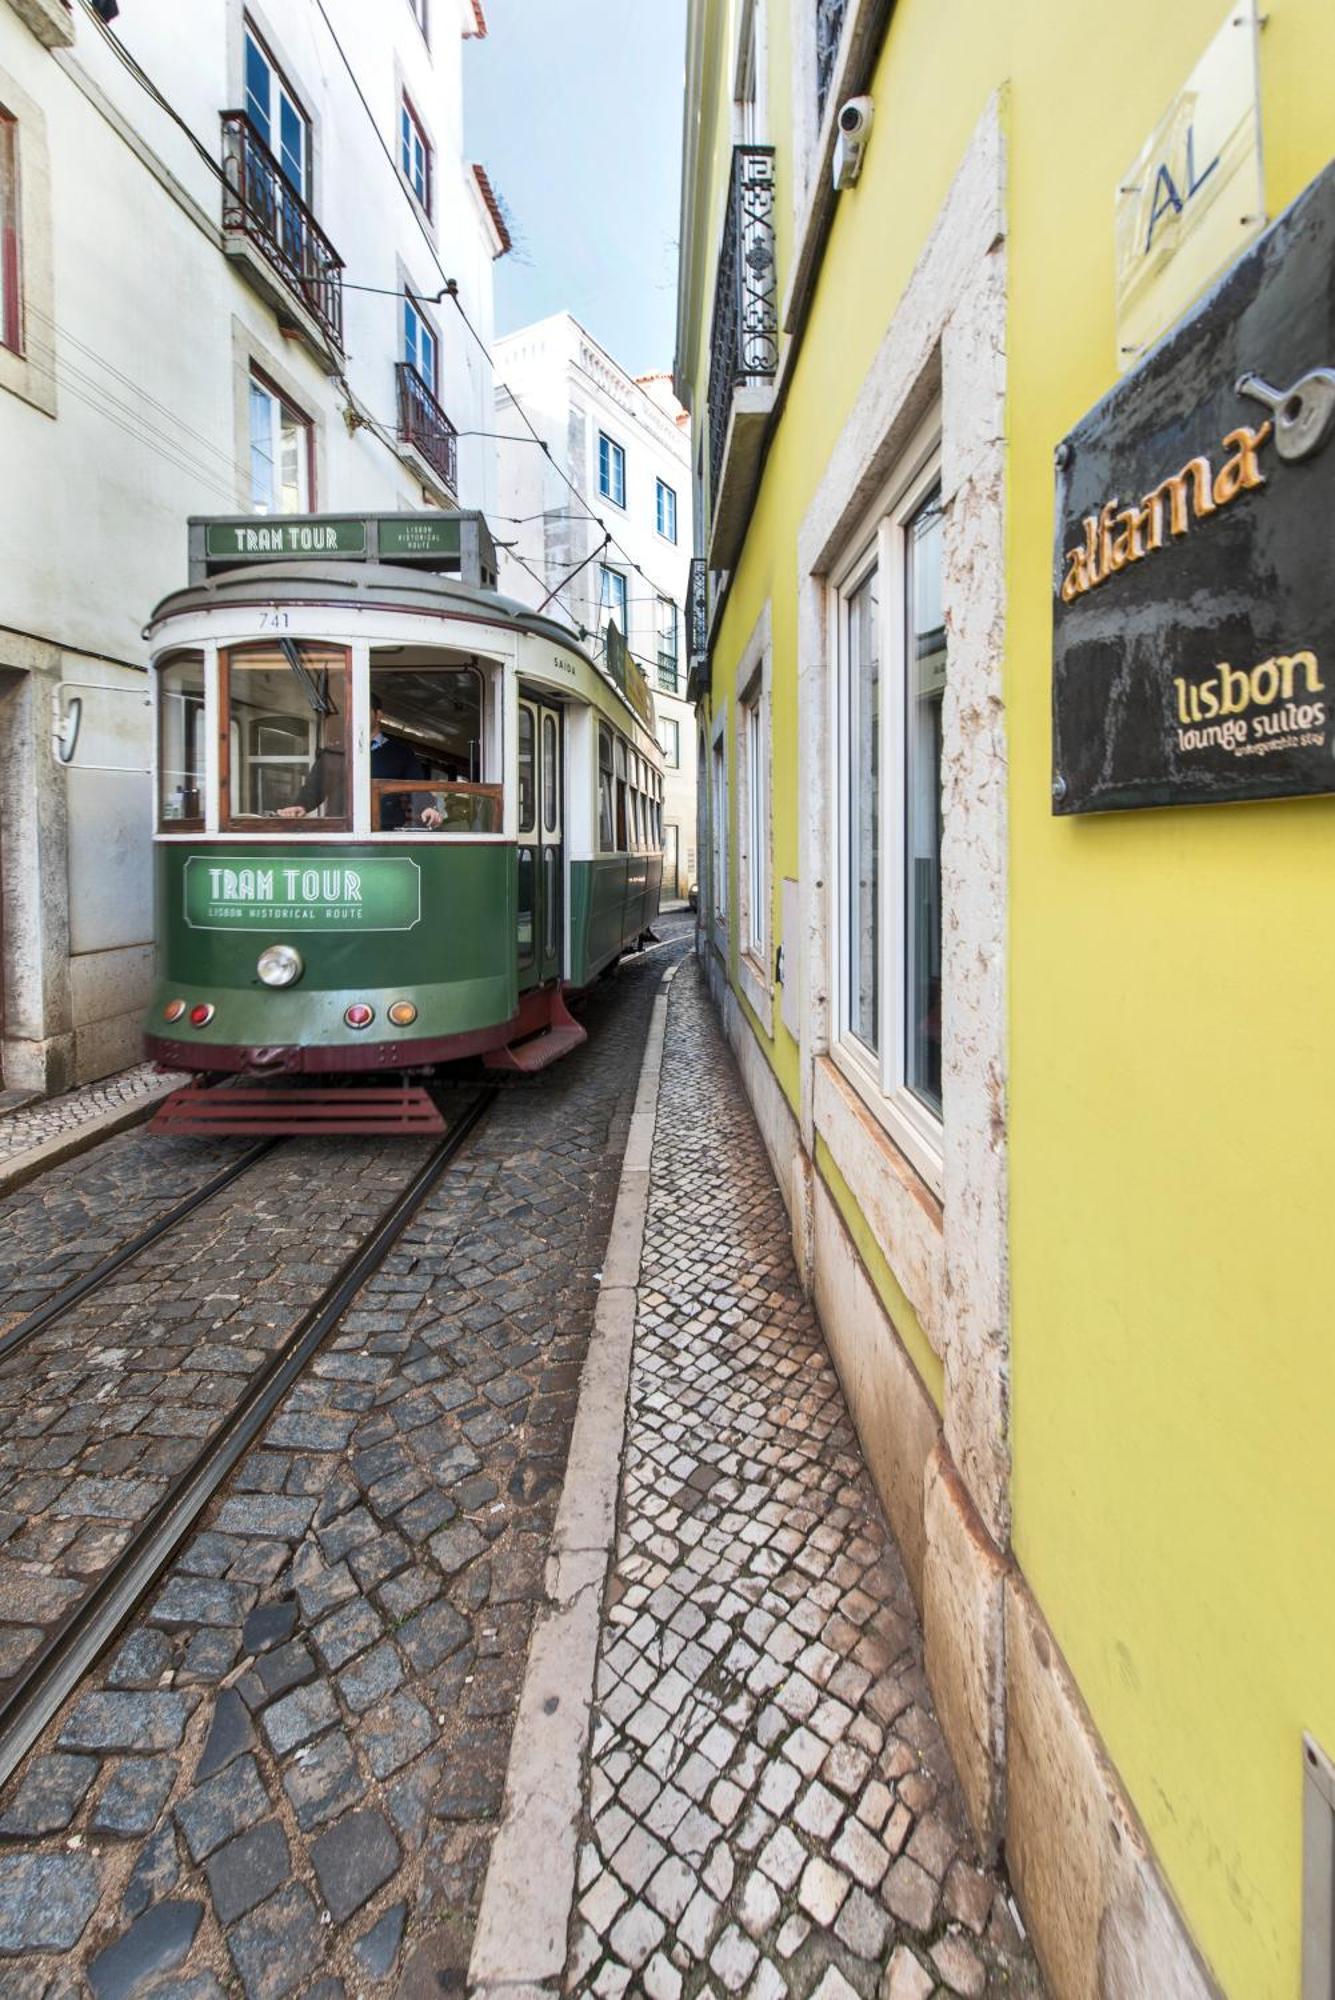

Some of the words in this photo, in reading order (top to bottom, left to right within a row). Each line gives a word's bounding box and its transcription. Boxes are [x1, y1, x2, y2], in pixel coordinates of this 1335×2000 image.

[1144, 125, 1220, 256] AL
[1061, 420, 1271, 602] alfama
[234, 528, 283, 551] TRAM
[288, 527, 338, 550] TOUR
[259, 613, 289, 629] 741
[1173, 650, 1326, 724] lisbon
[1178, 718, 1248, 751] lounge
[1252, 702, 1326, 738] suites
[208, 868, 274, 901] TRAM
[282, 869, 363, 901] TOUR
[208, 907, 242, 917] LISBON
[250, 908, 316, 919] HISTORICAL
[326, 908, 363, 919] ROUTE
